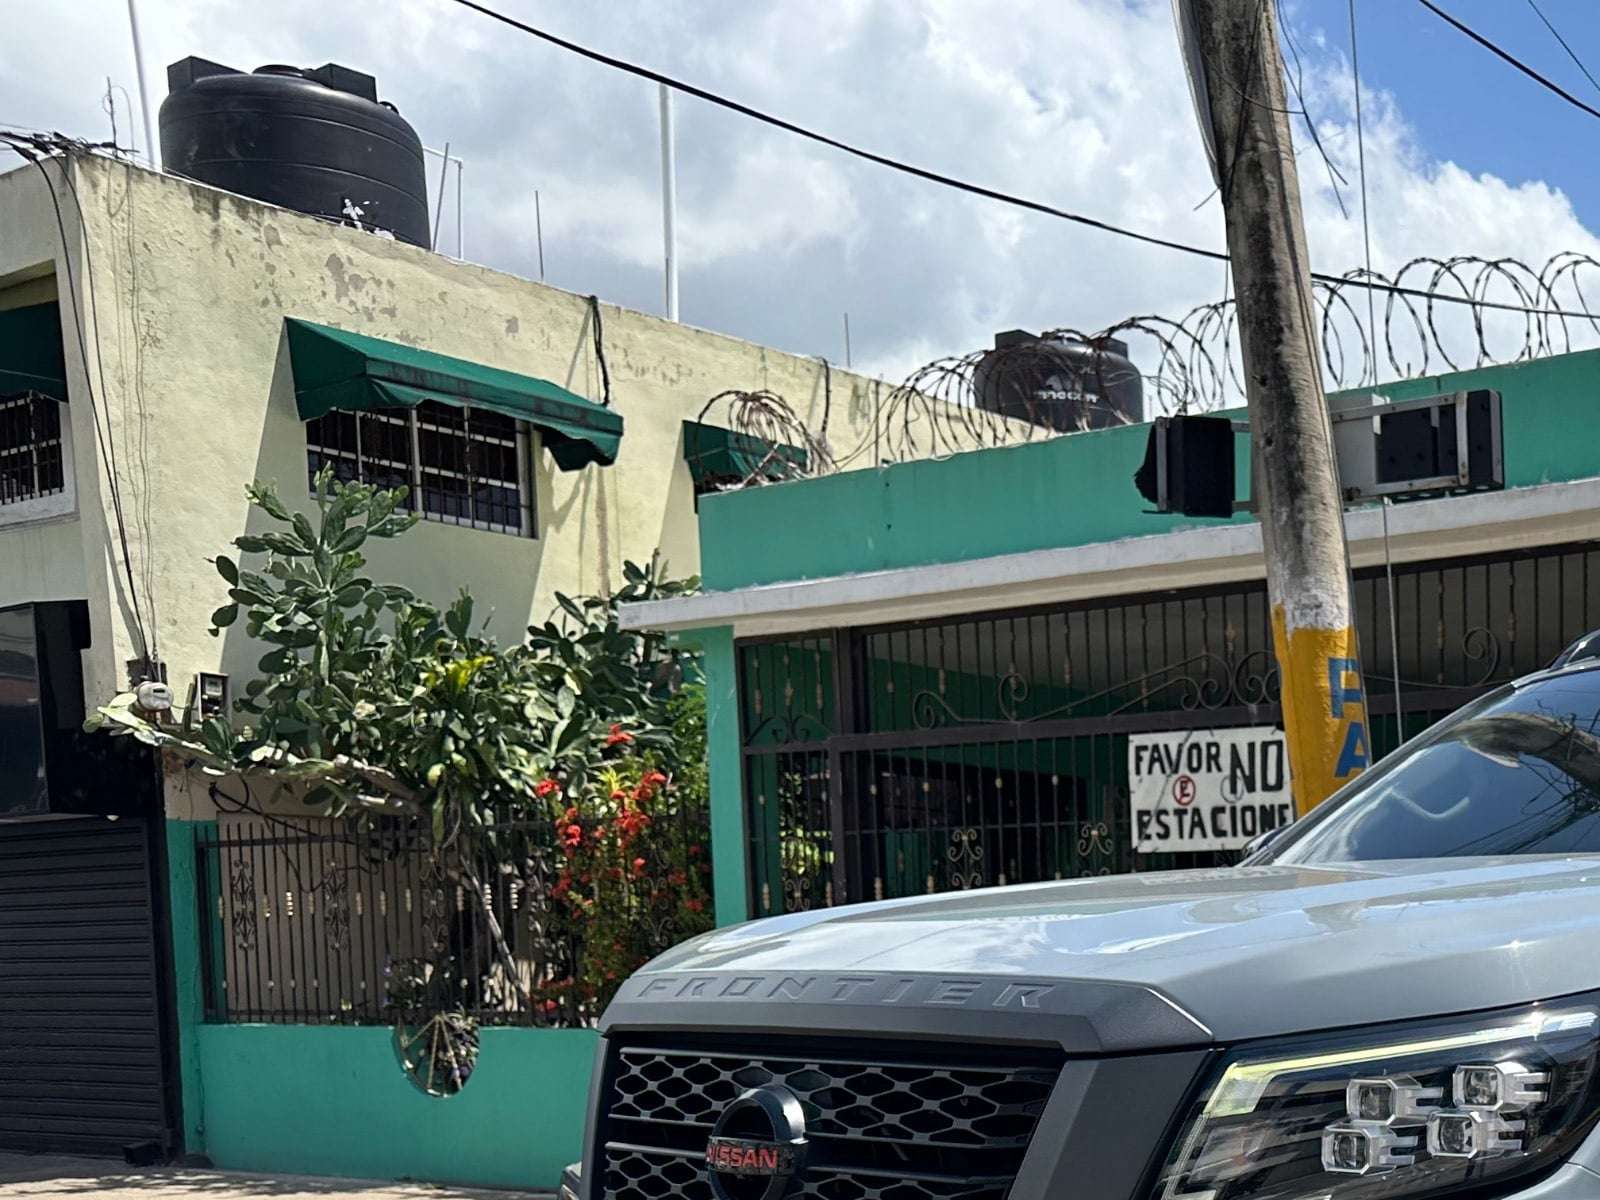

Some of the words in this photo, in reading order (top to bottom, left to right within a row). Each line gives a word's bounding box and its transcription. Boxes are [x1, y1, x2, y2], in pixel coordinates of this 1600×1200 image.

[1134, 741, 1223, 776] FAVOR
[1229, 739, 1284, 796] NO
[1136, 803, 1290, 841] ESTACIONE
[637, 976, 1057, 1009] FRONTIER
[706, 1143, 778, 1169] NISSAN
